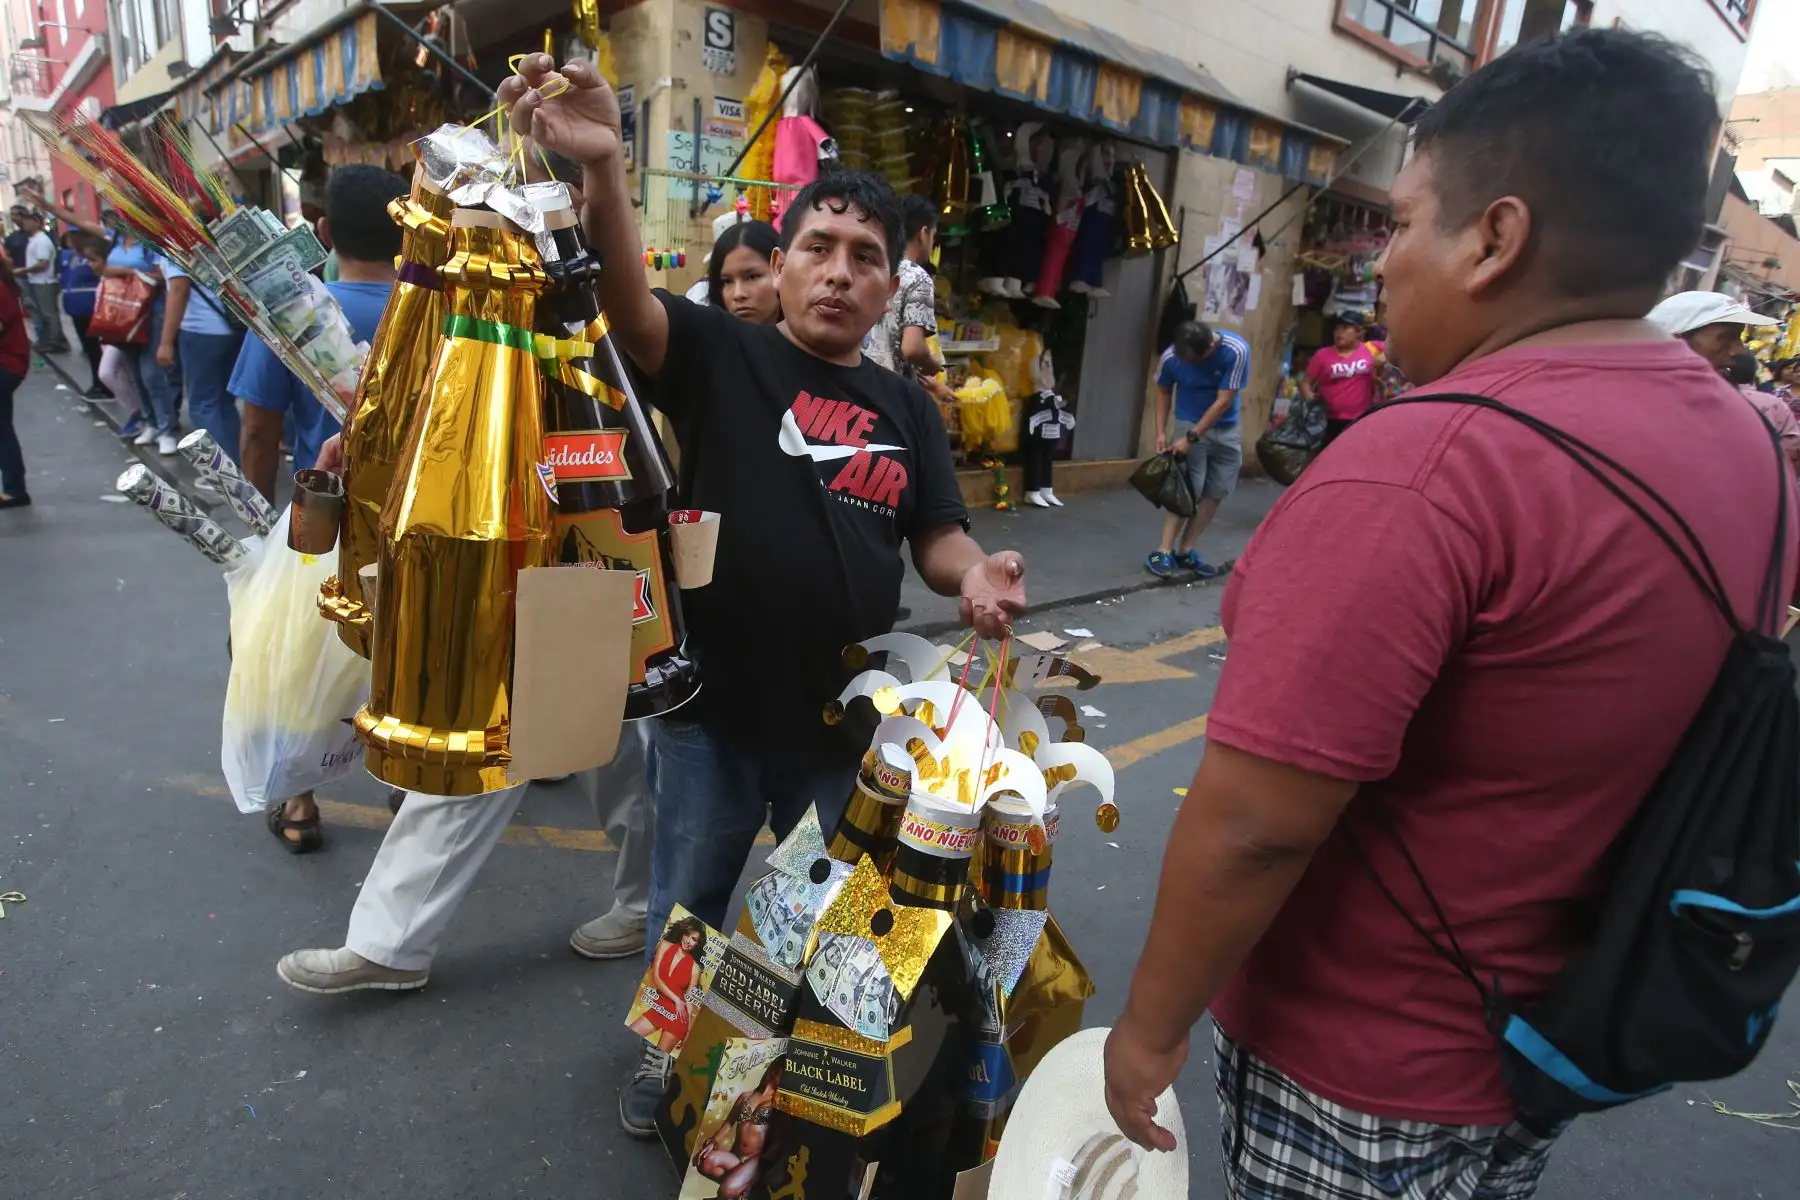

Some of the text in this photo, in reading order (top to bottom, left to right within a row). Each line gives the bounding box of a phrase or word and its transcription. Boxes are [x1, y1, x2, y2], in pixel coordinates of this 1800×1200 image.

[708, 11, 732, 48] S
[719, 103, 742, 118] VISA
[791, 390, 879, 449] NIKE
[548, 442, 614, 466] idades
[828, 449, 908, 509] AIR
[837, 494, 869, 510] JAPAN
[906, 821, 933, 843] AÑO
[992, 823, 1020, 843] AÑO
[719, 978, 781, 1026] RESERVE
[749, 979, 787, 1014] LABEL
[793, 1047, 819, 1060] JOHNNIE
[831, 1056, 857, 1070] WALKER
[785, 1058, 867, 1093] BLACK LABEL
